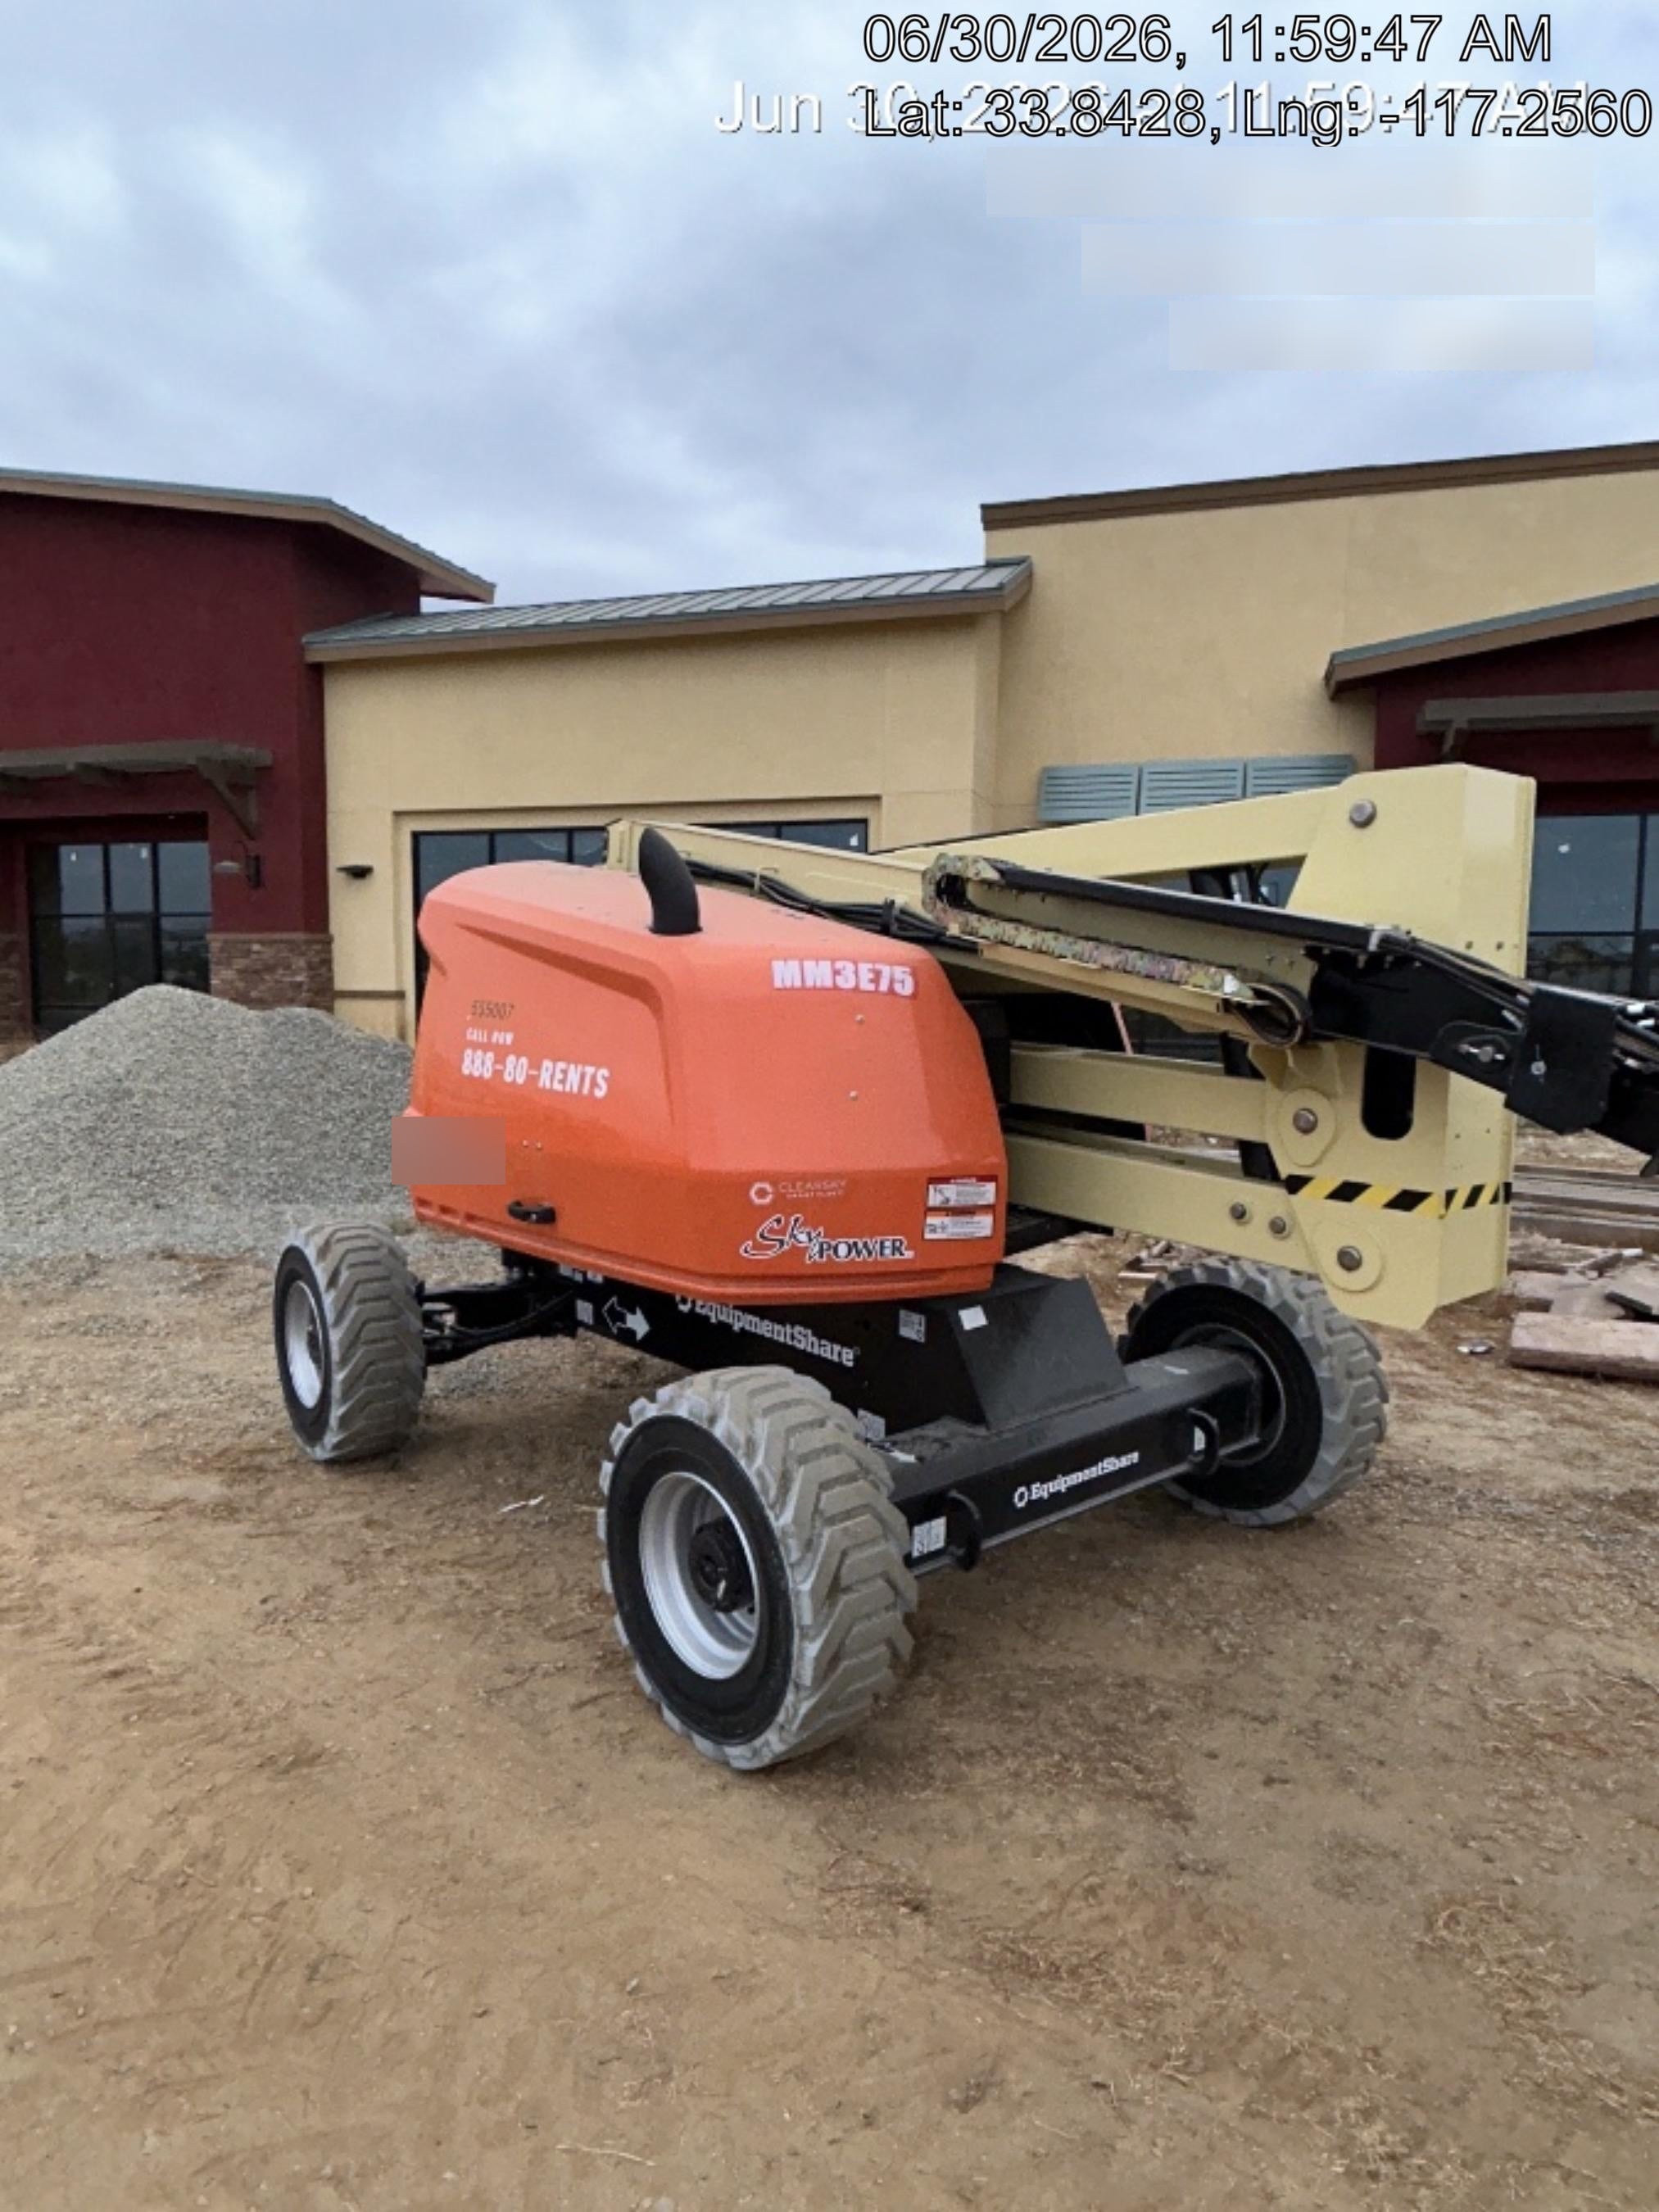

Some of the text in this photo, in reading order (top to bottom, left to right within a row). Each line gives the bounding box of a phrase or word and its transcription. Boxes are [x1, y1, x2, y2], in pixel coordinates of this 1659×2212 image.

[771, 959, 915, 996] MM3E75
[461, 1048, 610, 1099] 888-80-RENTS
[818, 1235, 911, 1263] POWER
